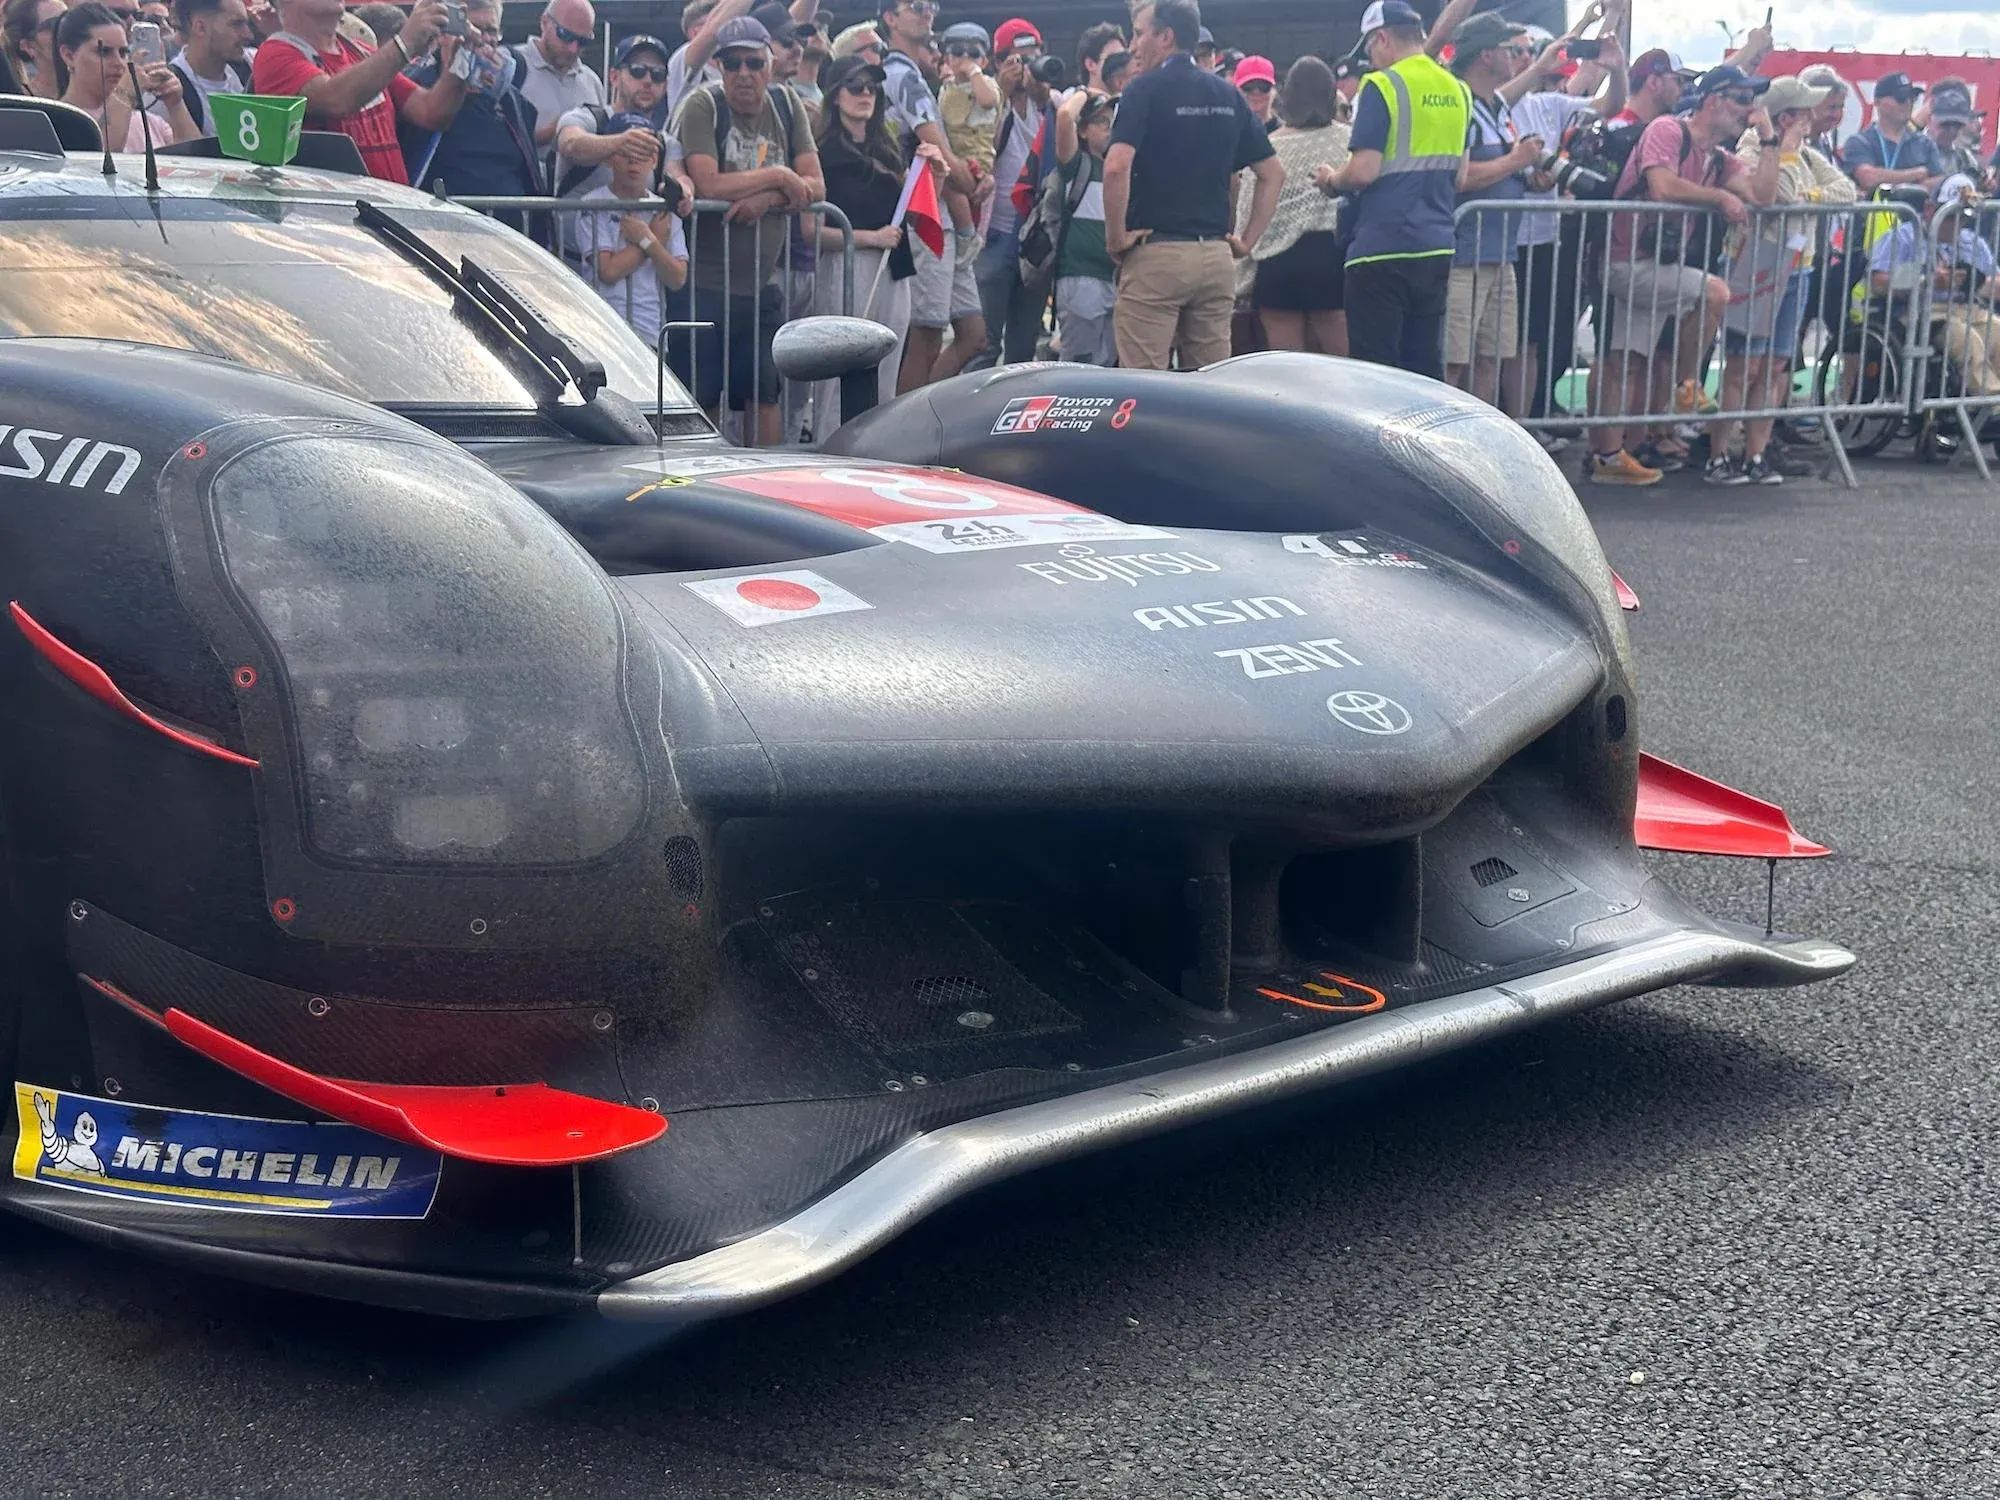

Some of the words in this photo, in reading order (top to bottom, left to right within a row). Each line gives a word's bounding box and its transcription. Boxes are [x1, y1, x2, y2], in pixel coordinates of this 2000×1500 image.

[1422, 94, 1458, 108] ACCUEIL
[238, 109, 260, 151] 8
[1046, 407, 1101, 418] GAZOO
[1056, 396, 1114, 407] TOYOTA
[1110, 398, 1137, 430] 8
[996, 410, 1040, 431] GR
[1040, 417, 1093, 432] Racing
[0, 424, 142, 495] SIN
[820, 468, 999, 510] 8
[924, 520, 1016, 541] 24h
[1016, 551, 1222, 587] FUJITSU
[1133, 596, 1308, 631] AISIN
[1213, 638, 1364, 680] ZENT
[112, 1135, 401, 1190] MICHELIN
